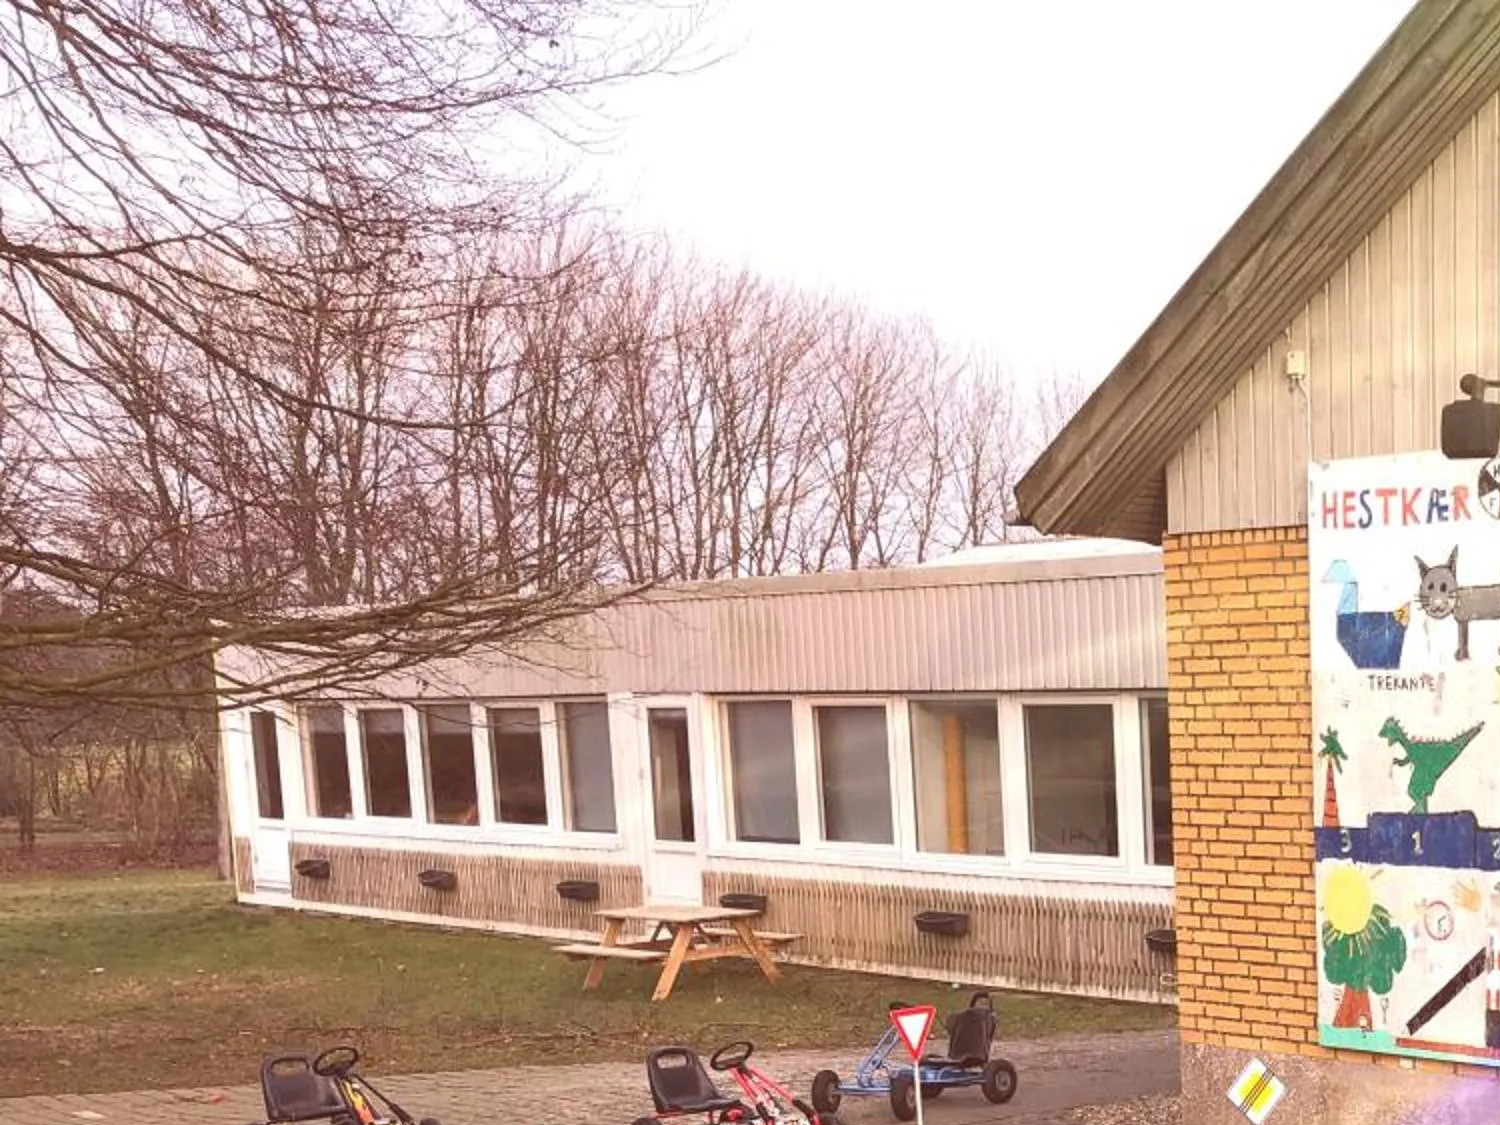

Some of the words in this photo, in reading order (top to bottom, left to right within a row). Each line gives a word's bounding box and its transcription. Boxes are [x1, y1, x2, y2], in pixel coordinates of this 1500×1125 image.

[1321, 485, 1472, 530] HESTKÆR
[1339, 828, 1352, 853] 3
[1411, 831, 1424, 856] 1
